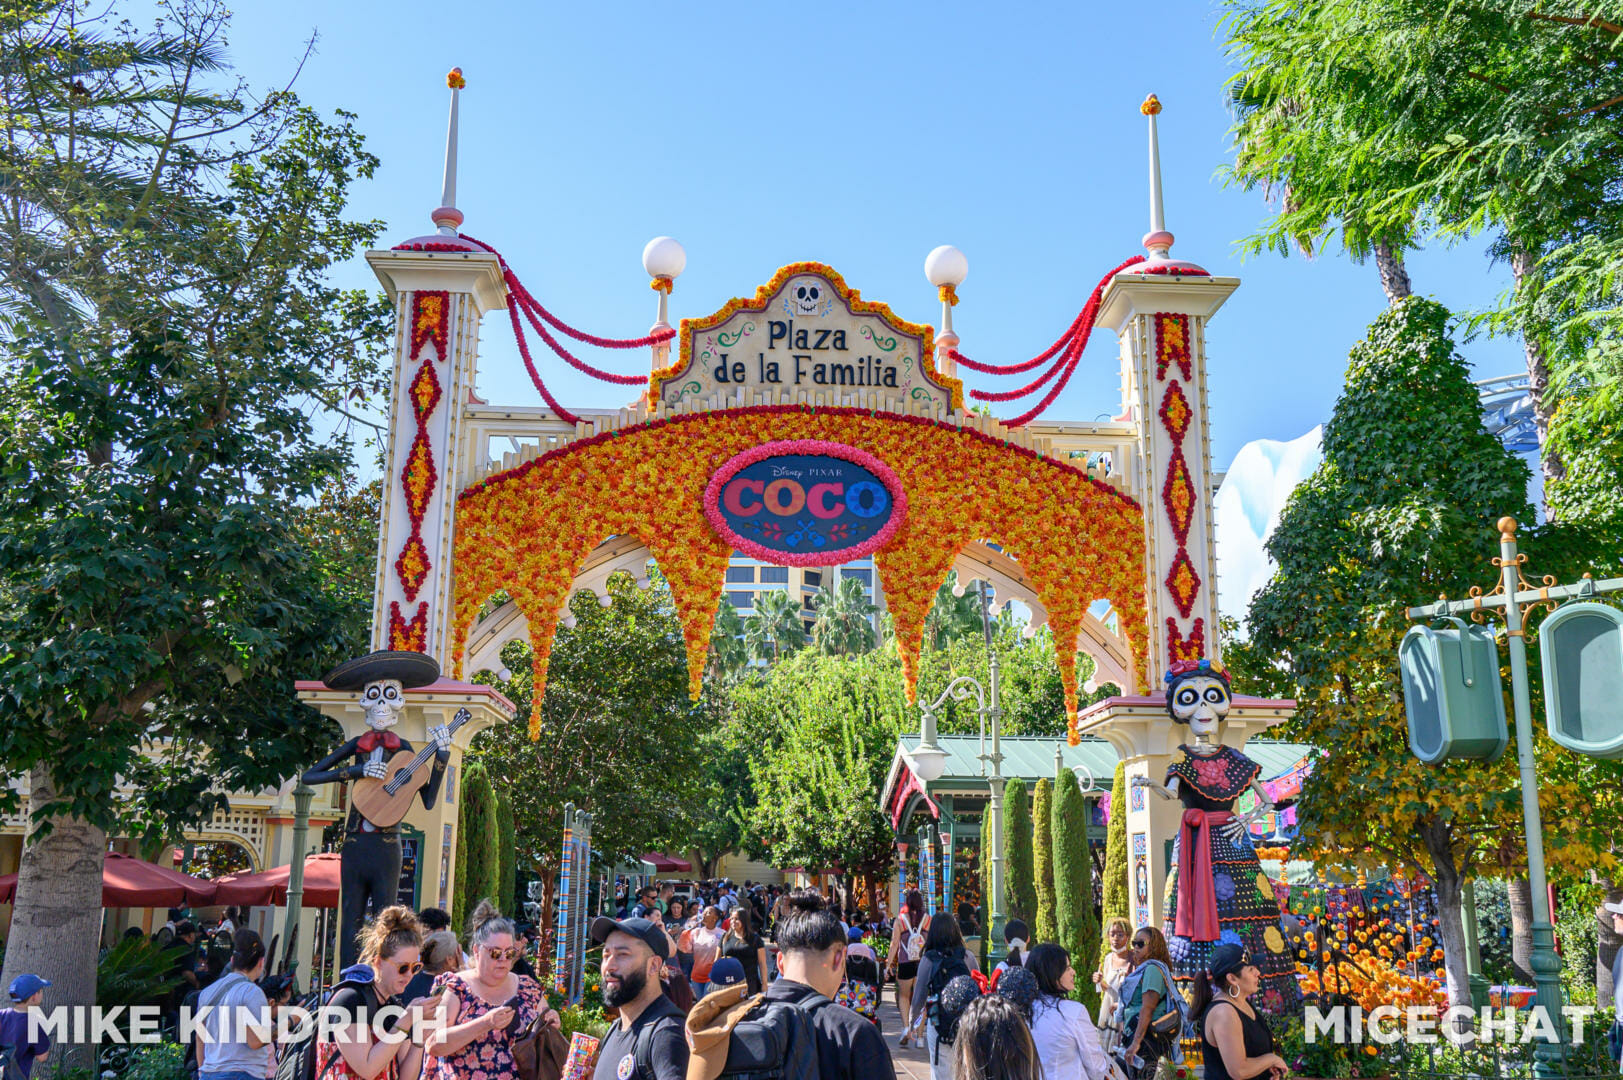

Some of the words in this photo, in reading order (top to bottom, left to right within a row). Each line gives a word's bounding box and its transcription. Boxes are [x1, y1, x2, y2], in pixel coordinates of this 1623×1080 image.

[768, 320, 848, 350] Plaza
[714, 353, 746, 384] de
[759, 353, 782, 384] la
[793, 354, 899, 387] Familia
[768, 465, 802, 479] Disney
[809, 468, 842, 477] PIXAR
[723, 478, 888, 520] COCO
